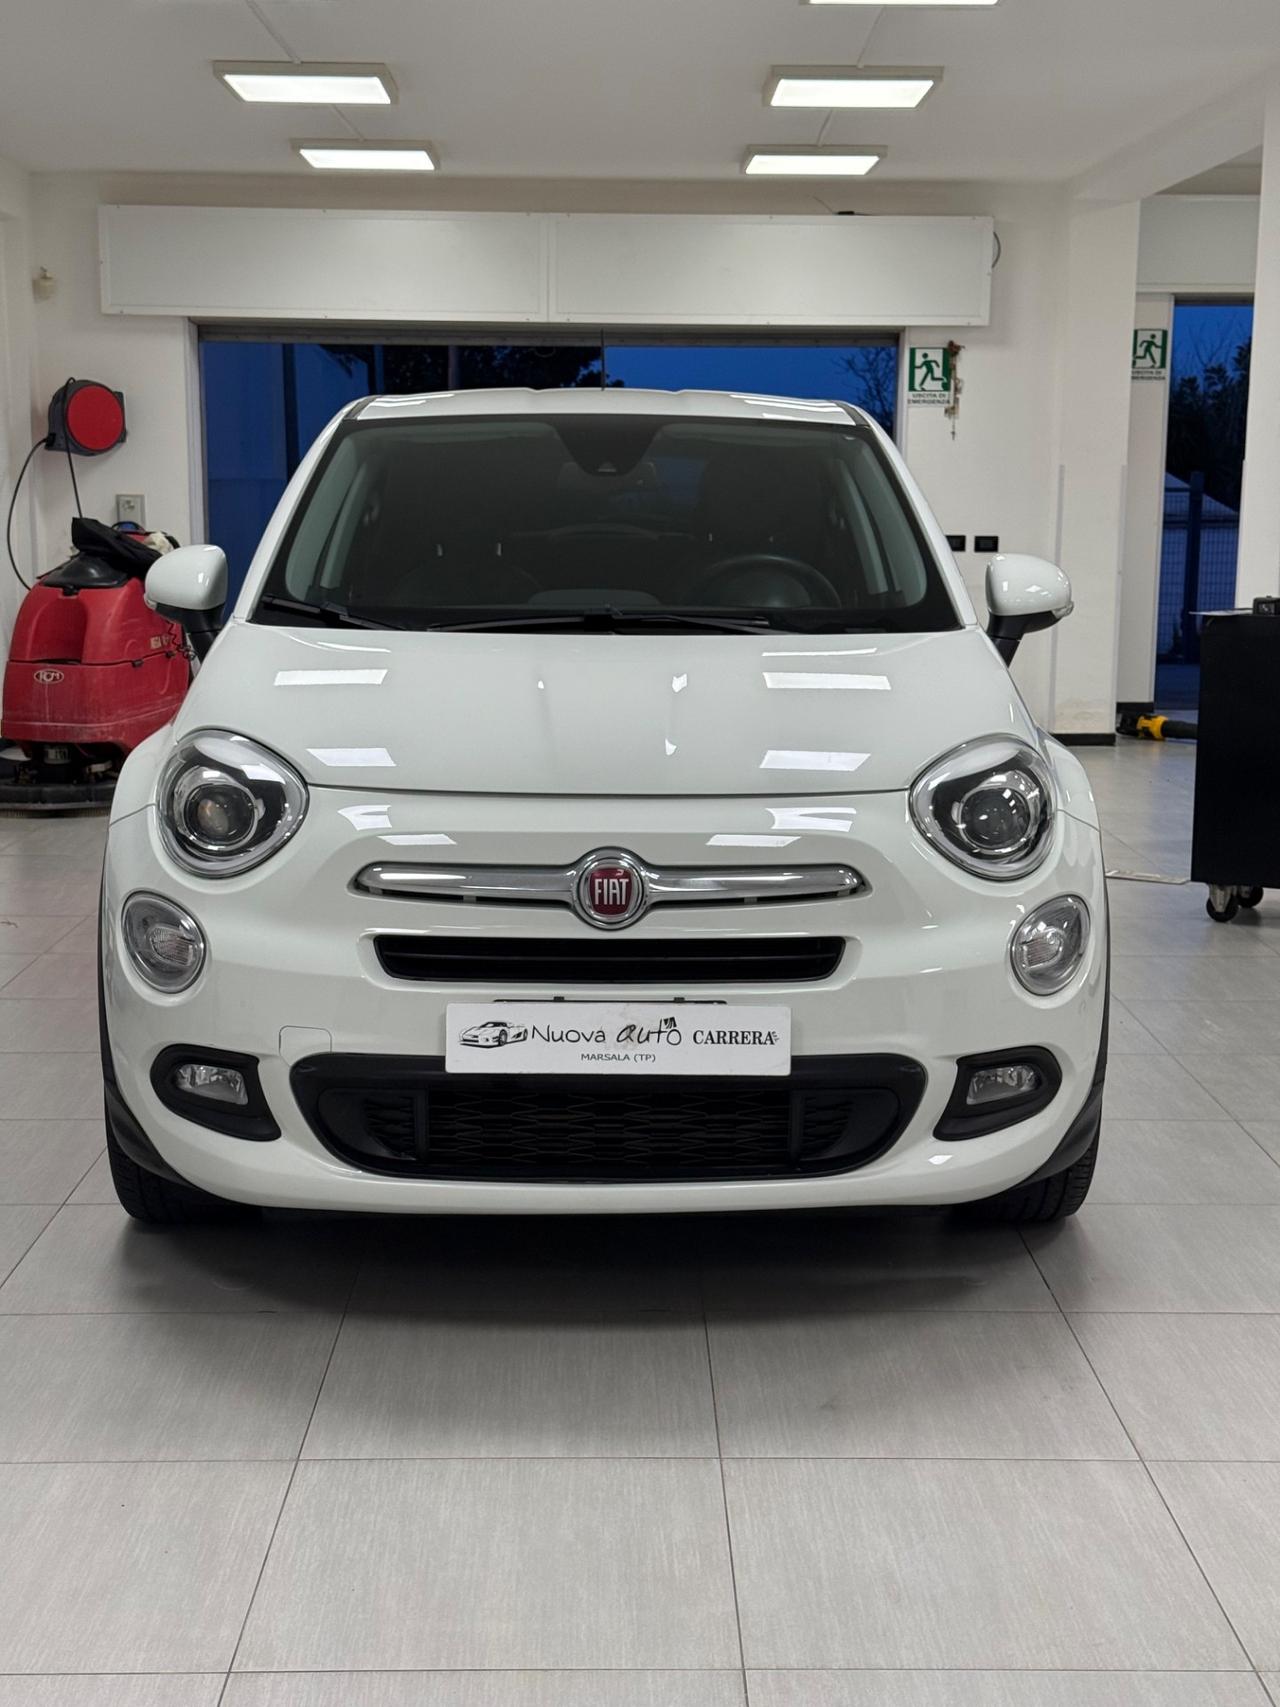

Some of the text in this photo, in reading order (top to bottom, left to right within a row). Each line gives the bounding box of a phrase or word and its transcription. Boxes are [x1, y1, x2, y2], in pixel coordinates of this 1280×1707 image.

[594, 878, 629, 905] FIAT
[531, 1024, 606, 1043] Nuova
[692, 1029, 775, 1046] CARRERA
[581, 1053, 656, 1063] MARSALA (TP)
